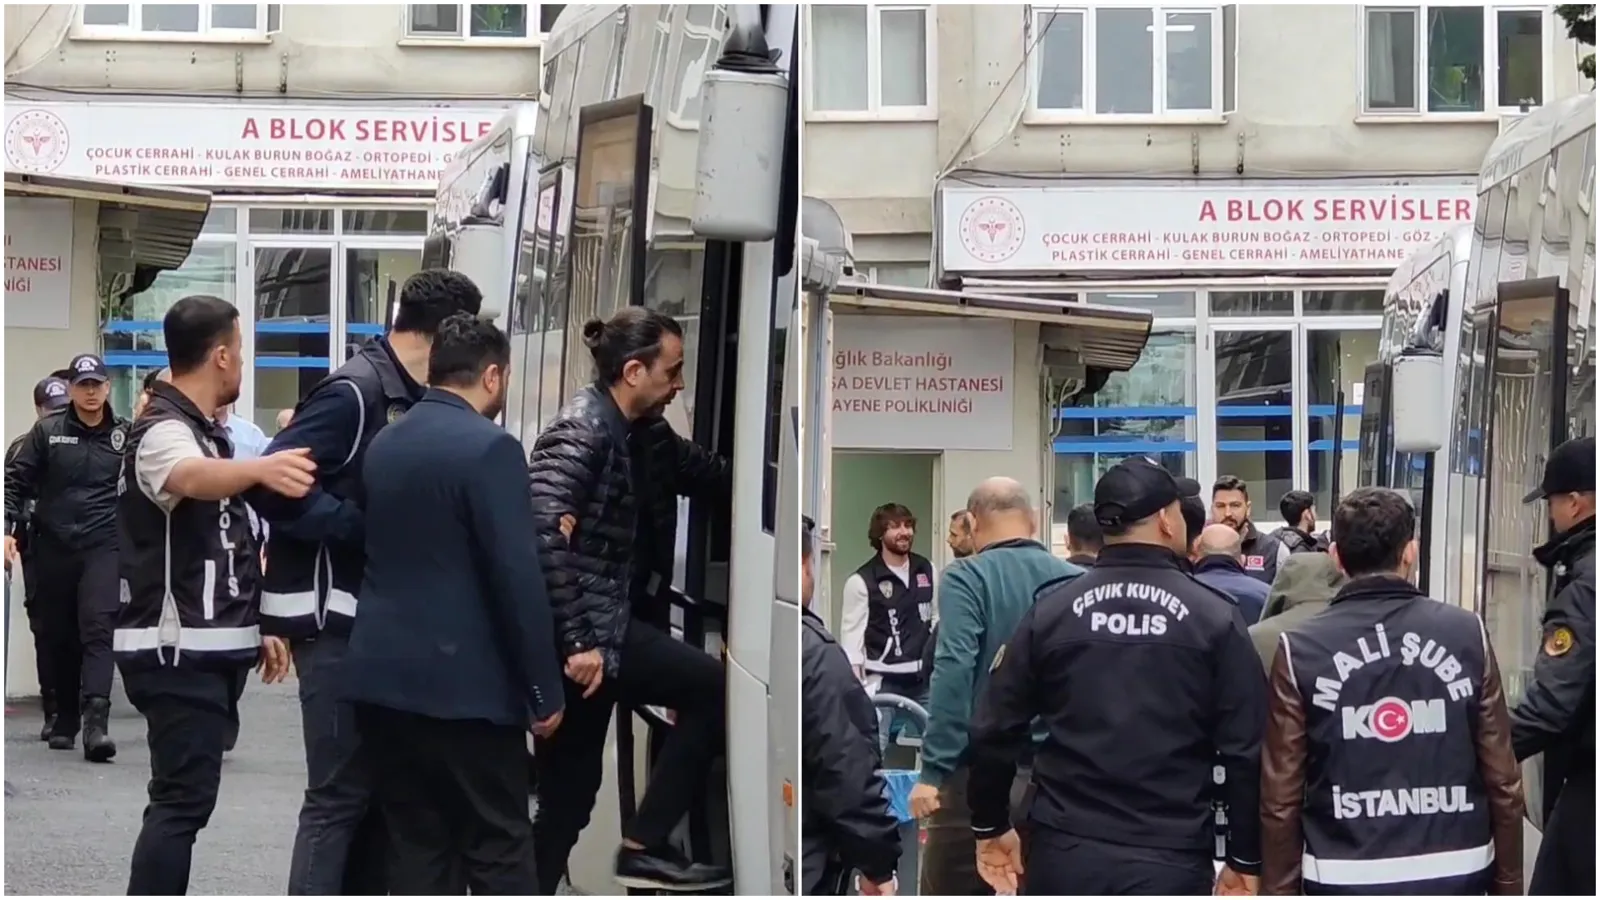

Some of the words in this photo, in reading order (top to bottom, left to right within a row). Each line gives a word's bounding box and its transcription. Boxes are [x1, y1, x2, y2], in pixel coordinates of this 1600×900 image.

[241, 117, 259, 140] A
[270, 118, 346, 141] BLOK
[86, 147, 133, 161] ÇOCUK
[136, 147, 194, 160] CERRAHİ
[205, 149, 250, 160] KULAK
[254, 149, 301, 161] BURUN
[305, 148, 352, 162] BOĞAZ
[363, 151, 431, 163] ORTOPEDİ
[95, 163, 151, 176] PLASTİK
[154, 164, 213, 177] CERRAHİ
[224, 166, 266, 177] GENEL
[270, 165, 329, 178] CERRAHİ
[340, 167, 444, 181] AMELİYATHANE
[1199, 200, 1217, 221] A
[1227, 199, 1304, 221] BLOK
[1313, 194, 1471, 221] SERVİSLER
[1042, 233, 1088, 247] ÇOCUK
[1092, 230, 1151, 244] CERRAHİ
[1163, 232, 1208, 243] KULAK
[1212, 232, 1259, 243] BURUN
[1263, 229, 1310, 242] BOĞAZ
[1322, 229, 1391, 242] ORTOPEDİ
[1403, 229, 1431, 242] GÖZ
[1052, 248, 1108, 261] PLASTİK
[1112, 248, 1170, 261] CERRAHİ
[1182, 249, 1225, 260] GENEL
[1229, 247, 1288, 260] CERRAHİ
[1300, 247, 1405, 259] AMELİYATHANE
[832, 350, 867, 370] ğlık
[872, 351, 952, 371] Bakanlığı
[852, 376, 912, 391] DEVLET
[915, 376, 1003, 392] HASTANESİ
[832, 399, 881, 412] AYENE
[884, 398, 973, 414] POLİKLİNİĞİ
[1072, 582, 1124, 618] ÇEVİK
[1126, 582, 1190, 622] KUVVET
[1312, 623, 1391, 712] MALİ
[1400, 632, 1474, 702] ŞUBE
[1341, 696, 1447, 743] KOM
[1332, 785, 1475, 820] İSTANBUL
